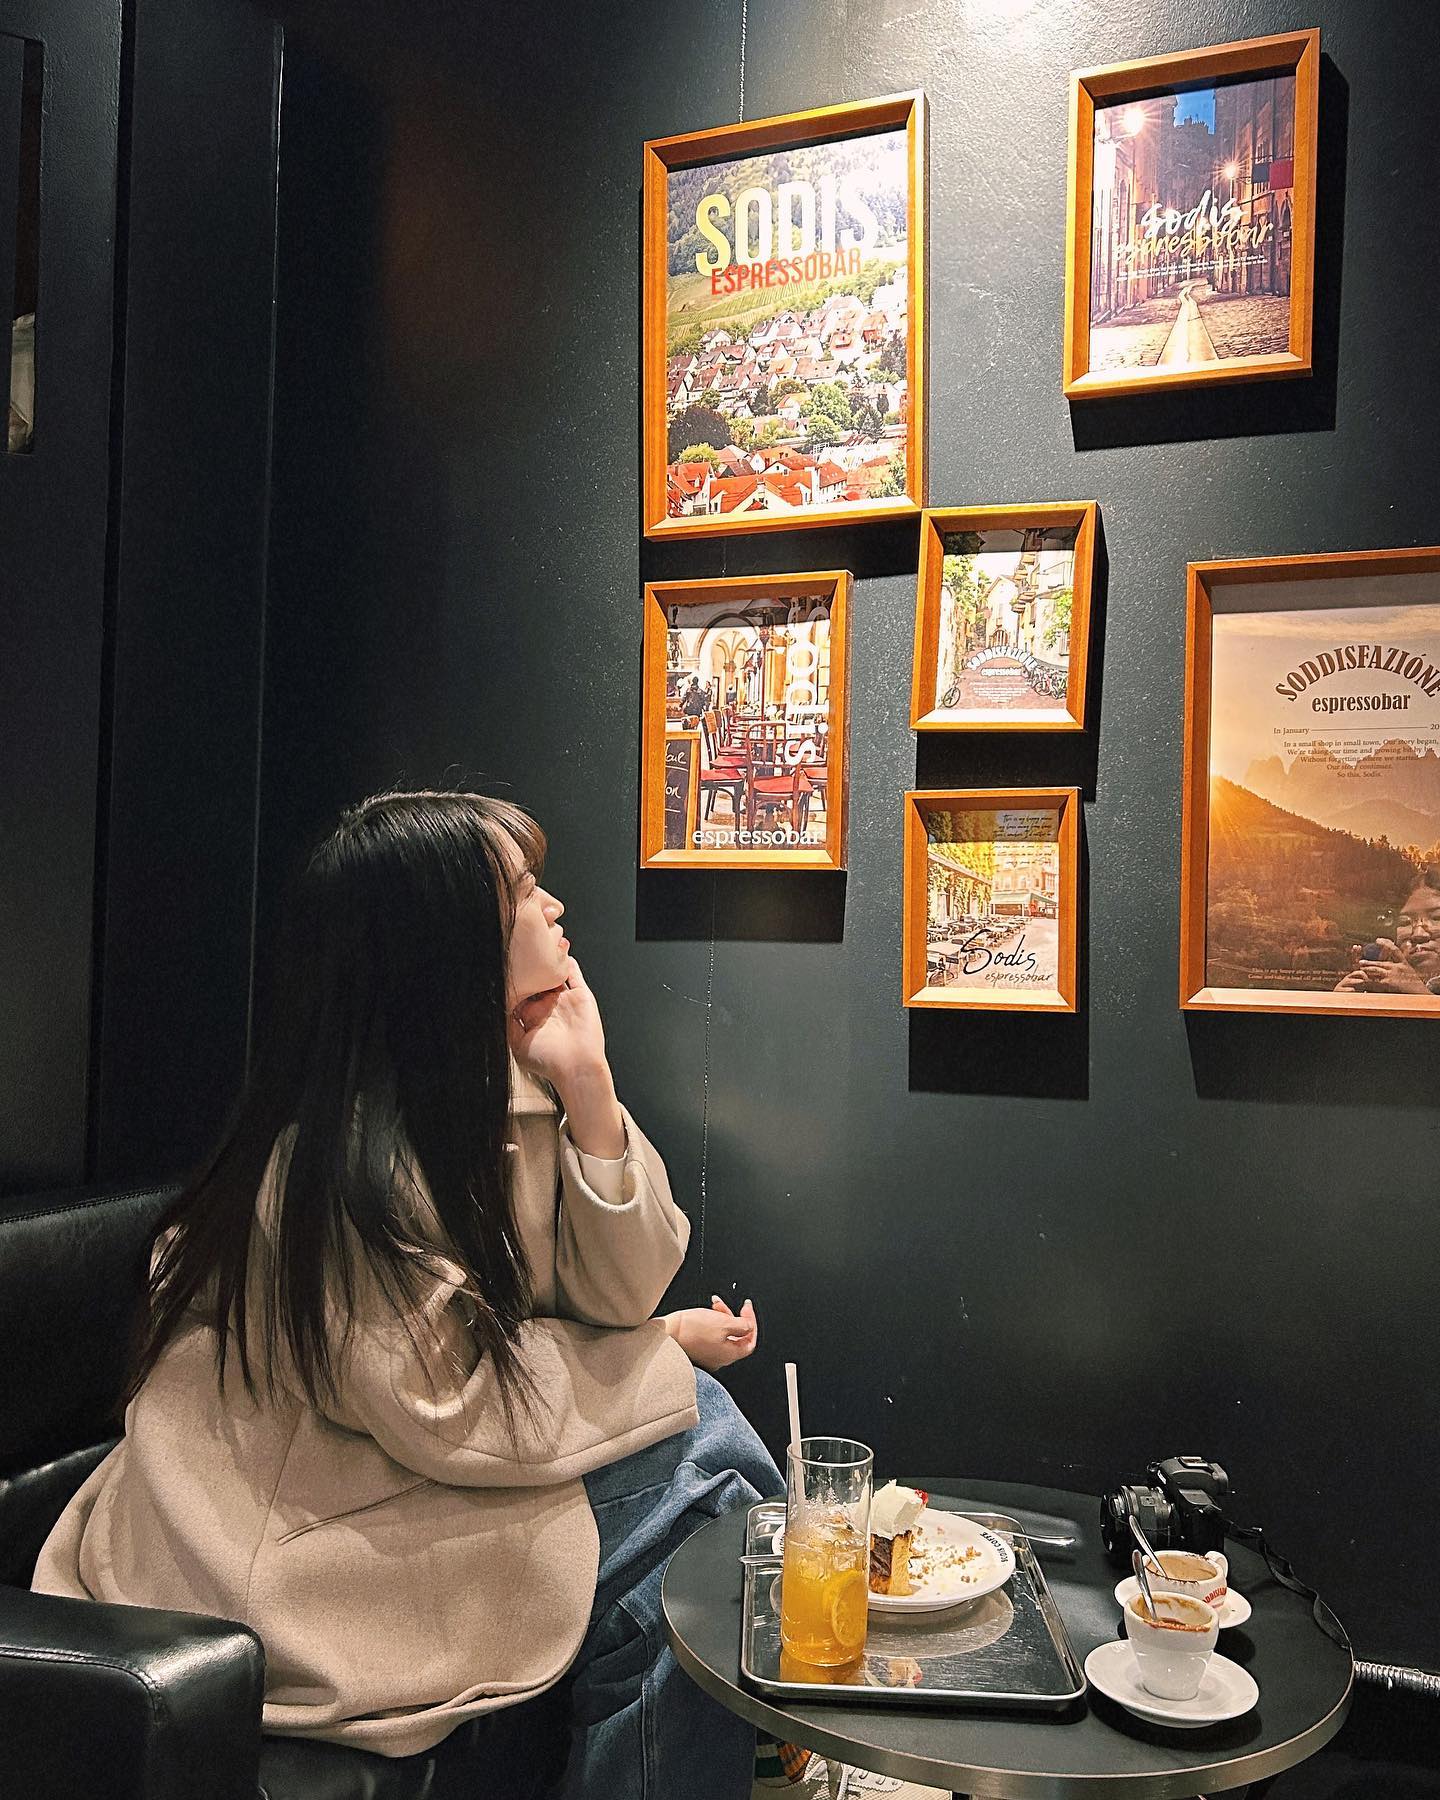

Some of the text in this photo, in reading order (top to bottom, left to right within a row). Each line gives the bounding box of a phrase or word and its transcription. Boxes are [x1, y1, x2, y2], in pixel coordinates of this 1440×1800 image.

[695, 171, 879, 277] SODIS
[711, 246, 862, 296] ESPRESSOBAR
[1311, 693, 1411, 714] espressobar
[1283, 728, 1310, 736] January
[1317, 740, 1334, 748] shop
[1416, 738, 1439, 746] began,
[1307, 748, 1329, 756] taking
[692, 827, 821, 849] espressobar
[960, 928, 1036, 975] Sodis
[984, 964, 1055, 987] espressobar
